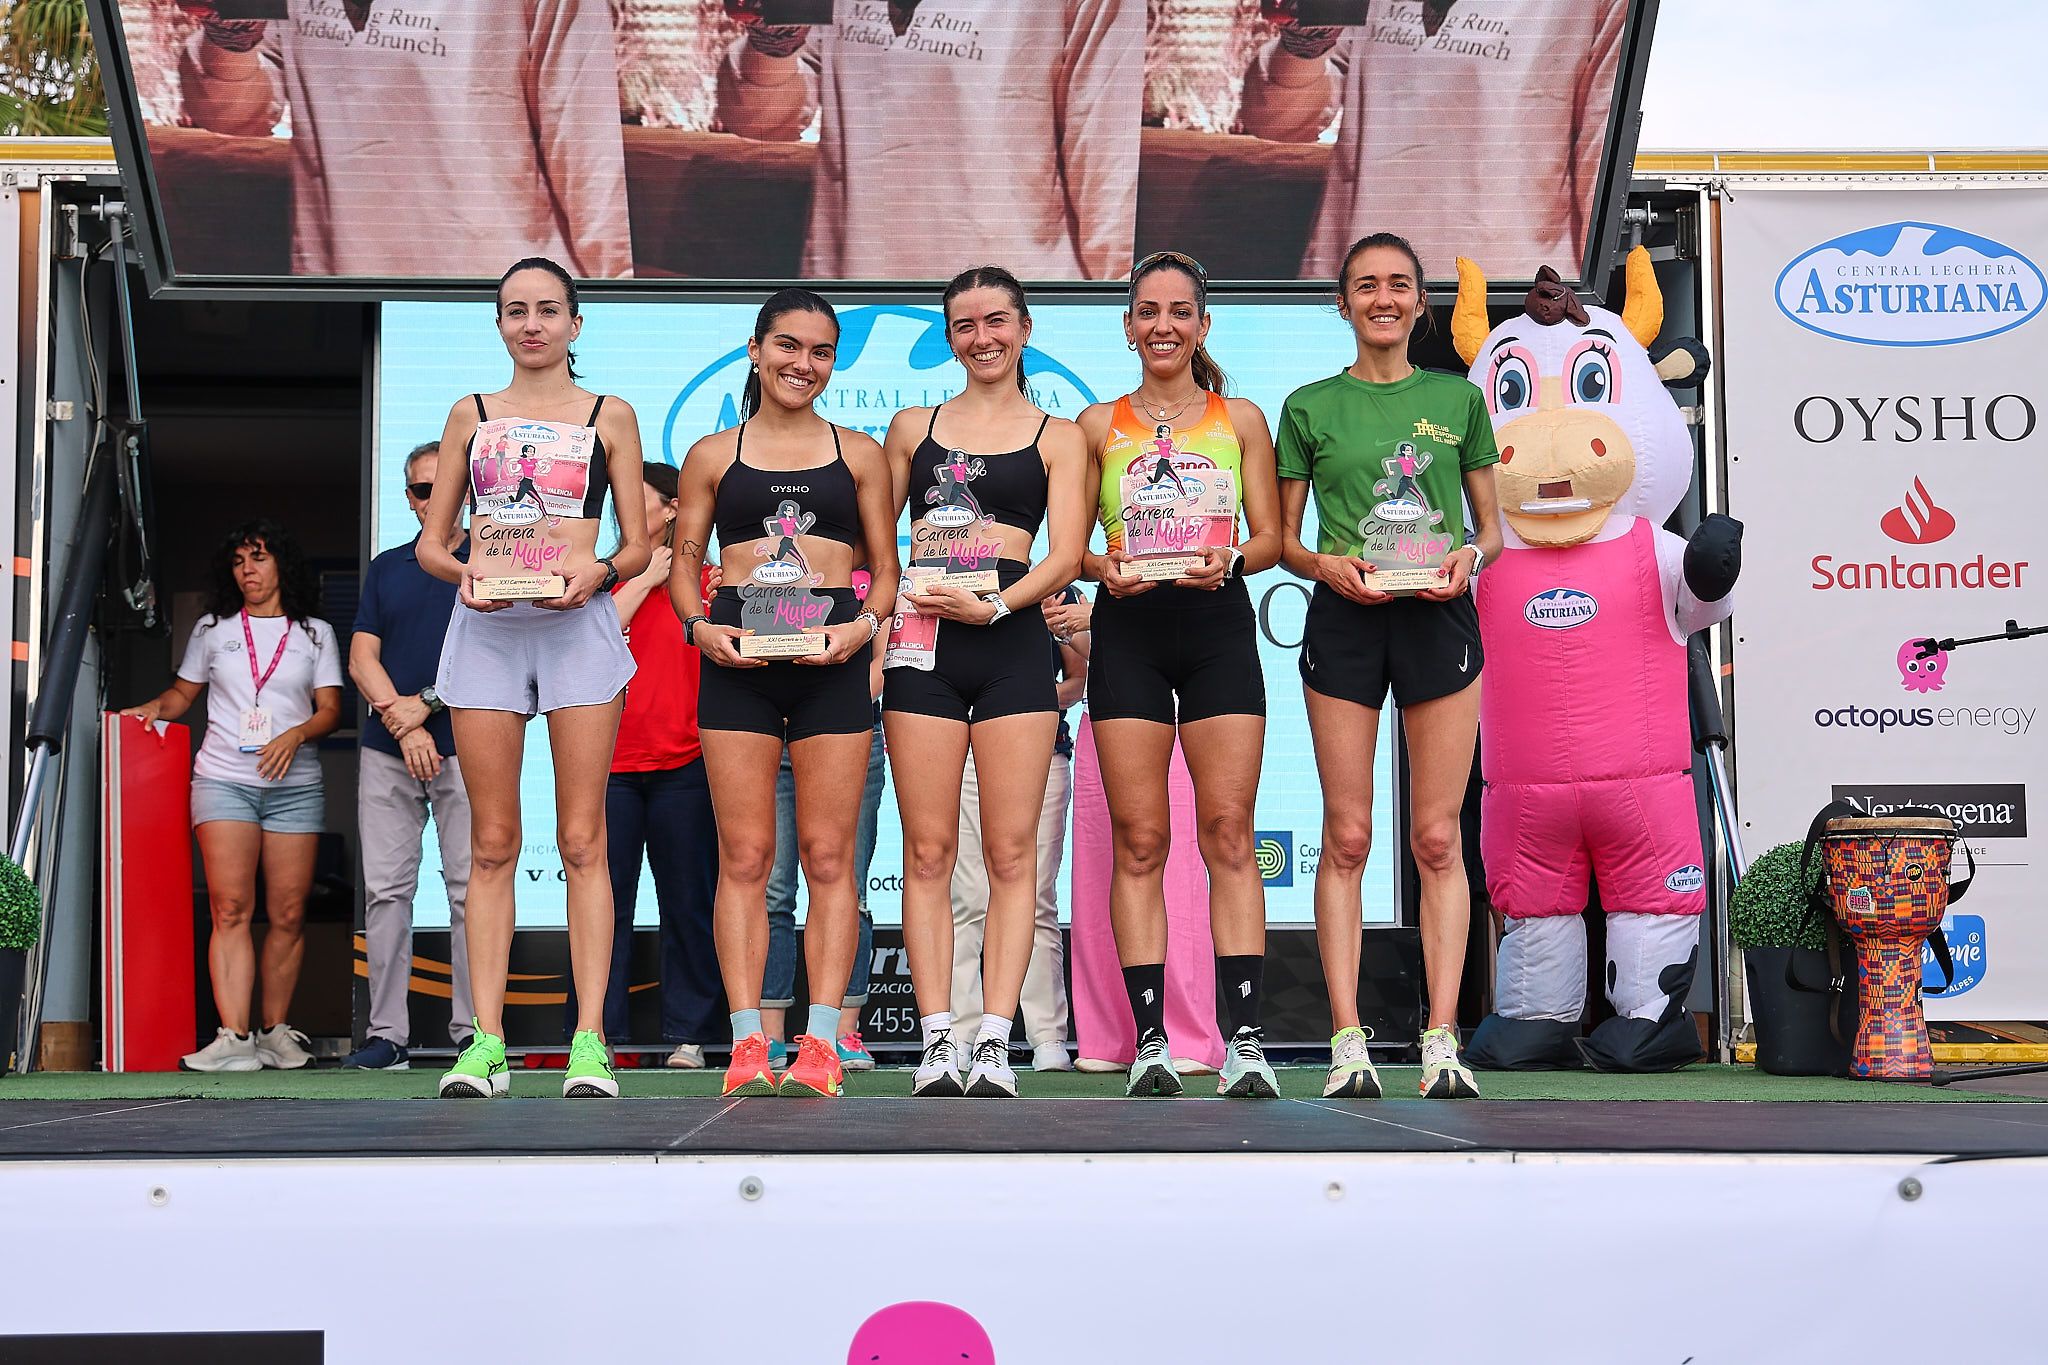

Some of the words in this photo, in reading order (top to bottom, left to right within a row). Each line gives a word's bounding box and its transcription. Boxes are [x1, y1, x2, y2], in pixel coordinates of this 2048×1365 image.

[365, 28, 447, 57] Brunch
[905, 32, 983, 61] Brunch
[1433, 33, 1511, 61] Brunch
[1837, 265, 1921, 277] CENTRAL
[1931, 264, 2017, 276] LECHERA
[1795, 268, 2028, 314] ASTURIANA
[1793, 394, 2037, 443] OYSHO
[511, 430, 556, 441] ASTURIANA
[547, 487, 573, 496] VALENCIA
[771, 485, 809, 493] OYSHO
[1137, 493, 1176, 501] ASTURIANA
[496, 511, 537, 519] ASTURIANA
[931, 514, 970, 522] ASTURIANA
[1121, 506, 1174, 521] Carrera
[1380, 506, 1419, 516] ASTURIANA
[480, 525, 535, 540] Carrera
[916, 527, 969, 542] Carrera
[1129, 523, 1141, 537] de
[1145, 523, 1153, 536] la
[1154, 517, 1207, 550] Mujer
[1363, 521, 1417, 535] Carrera
[486, 542, 498, 556] de
[502, 542, 511, 555] la
[510, 538, 568, 571] Mujer
[924, 543, 935, 557] de
[939, 543, 948, 555] la
[947, 537, 1001, 570] Mujer
[1371, 538, 1383, 551] de
[1387, 538, 1395, 550] la
[1395, 532, 1450, 566] Mujer
[759, 570, 798, 578] ASTURIANA
[1811, 554, 2029, 590] Santander
[535, 577, 551, 587] Mujer
[743, 583, 796, 598] Carrera
[749, 601, 762, 615] de
[766, 600, 774, 614] la
[773, 596, 829, 630] Mujer
[1530, 604, 1592, 618] ASTURIANA
[1814, 704, 1934, 733] octopus
[1937, 707, 2037, 735] energy
[1949, 975, 1974, 993] ALPES
